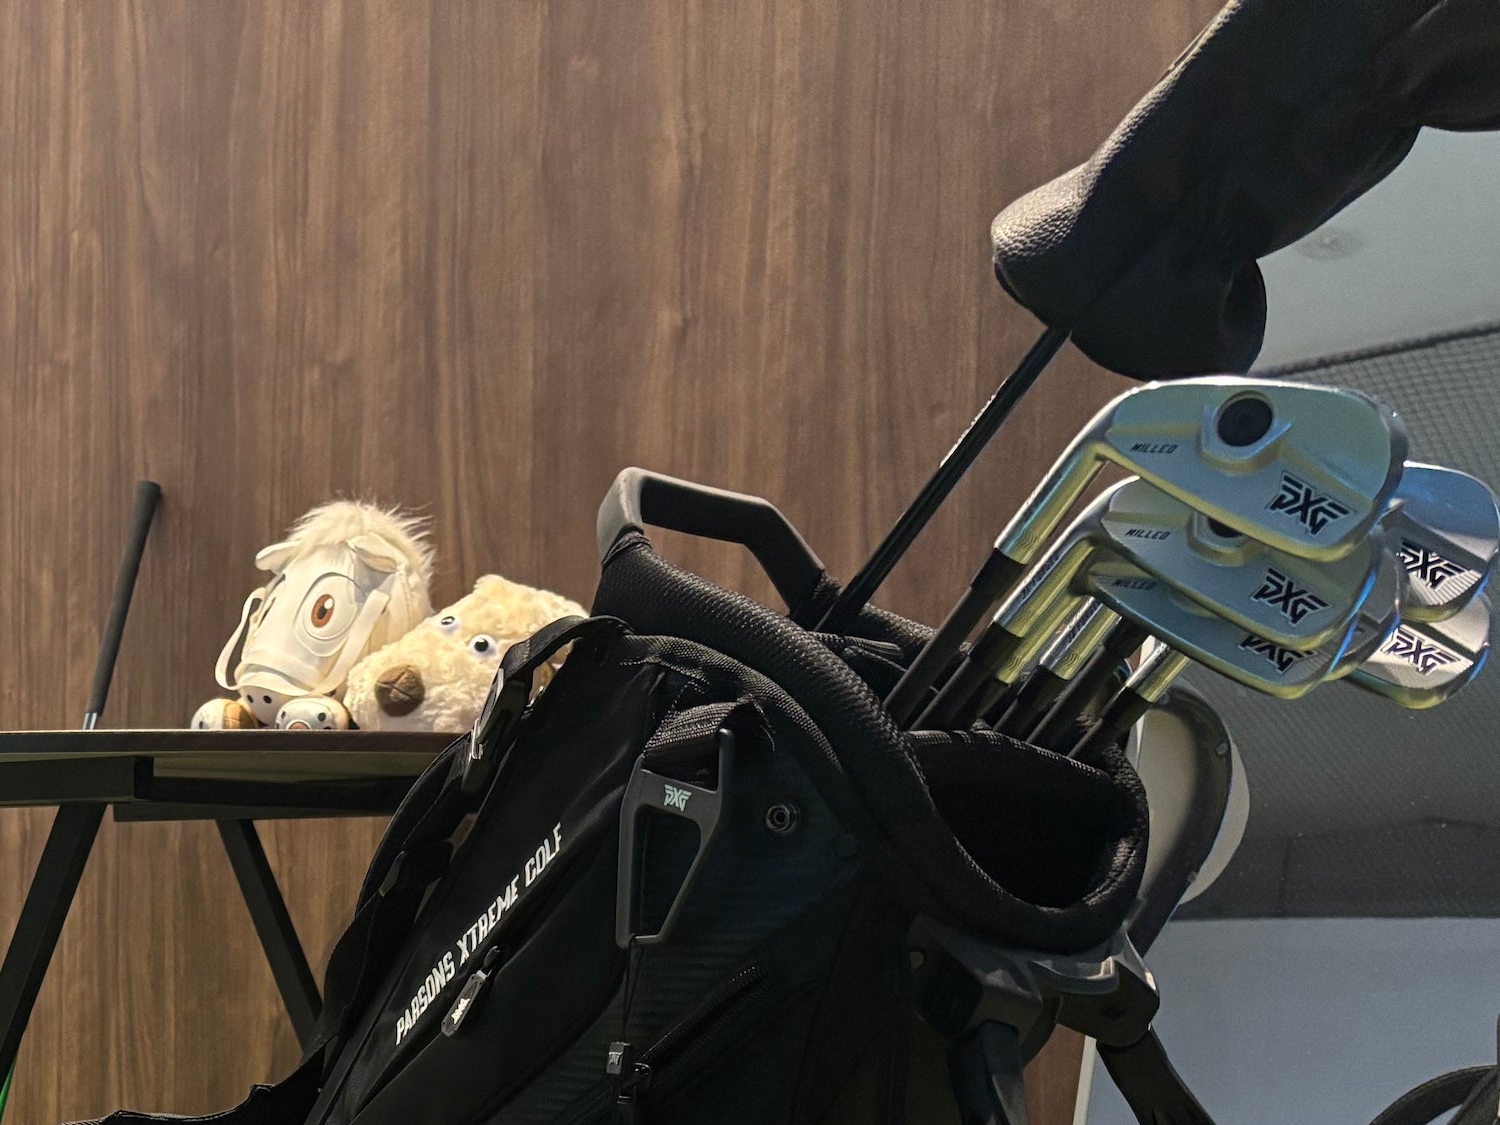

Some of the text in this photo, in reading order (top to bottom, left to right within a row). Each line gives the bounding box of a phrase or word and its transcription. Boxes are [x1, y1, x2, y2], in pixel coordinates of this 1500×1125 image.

[1130, 442, 1178, 455] MILLED
[1269, 471, 1350, 535] PXG
[1124, 528, 1171, 540] MILLED
[1251, 567, 1330, 625] PXG
[1387, 627, 1461, 675] PXG
[664, 784, 692, 812] PXG
[396, 822, 562, 1046] PARSONS XTREME GOLF
